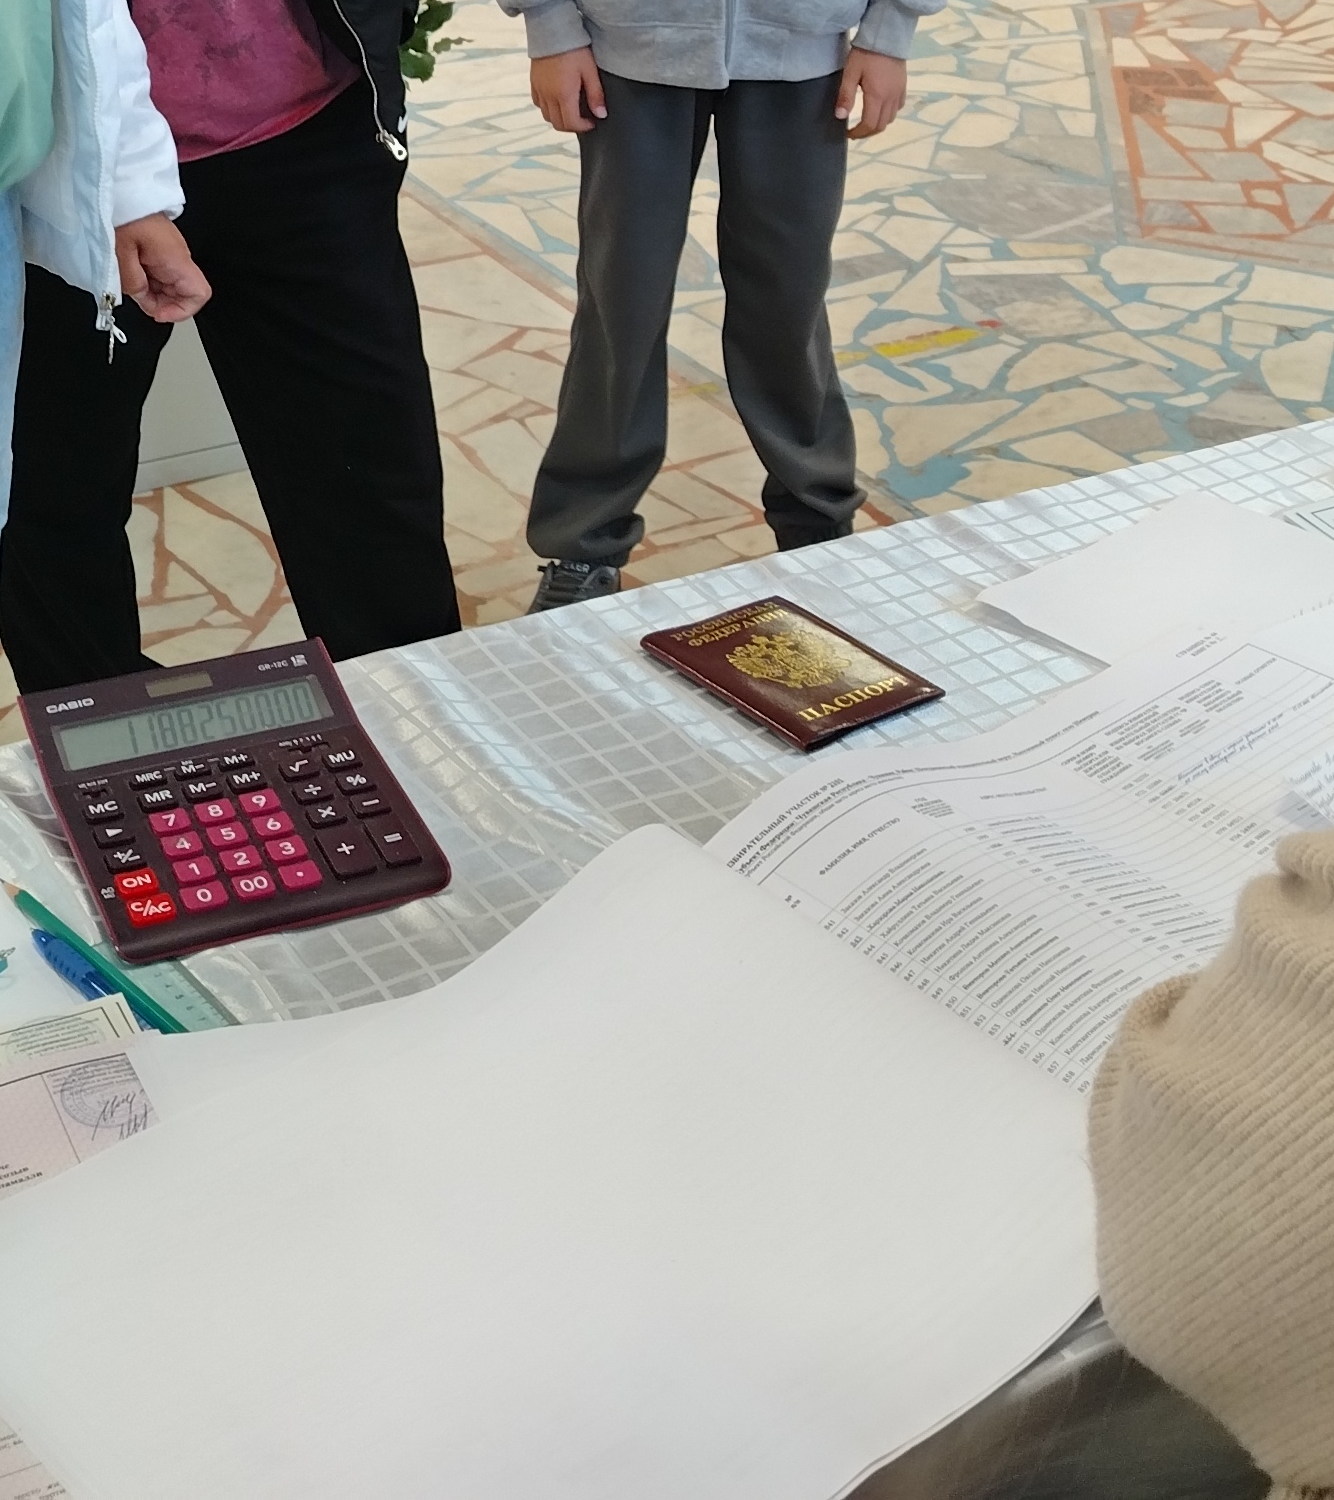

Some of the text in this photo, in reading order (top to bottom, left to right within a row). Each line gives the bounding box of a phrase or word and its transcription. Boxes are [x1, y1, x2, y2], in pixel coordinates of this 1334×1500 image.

[45, 697, 95, 714] CASIO
[797, 675, 910, 722] ПАСПОРТ
[88, 800, 118, 815] MC
[144, 789, 173, 803] MR
[233, 771, 261, 785] M+
[328, 750, 355, 764] MU
[135, 771, 162, 783] MRC
[161, 813, 176, 827] 7
[207, 804, 223, 817] 8
[251, 794, 267, 808] 9
[175, 817, 282, 850] 4 5 6
[188, 841, 295, 875] 1 2 3
[122, 873, 152, 888] ON
[130, 899, 171, 917] C/AC
